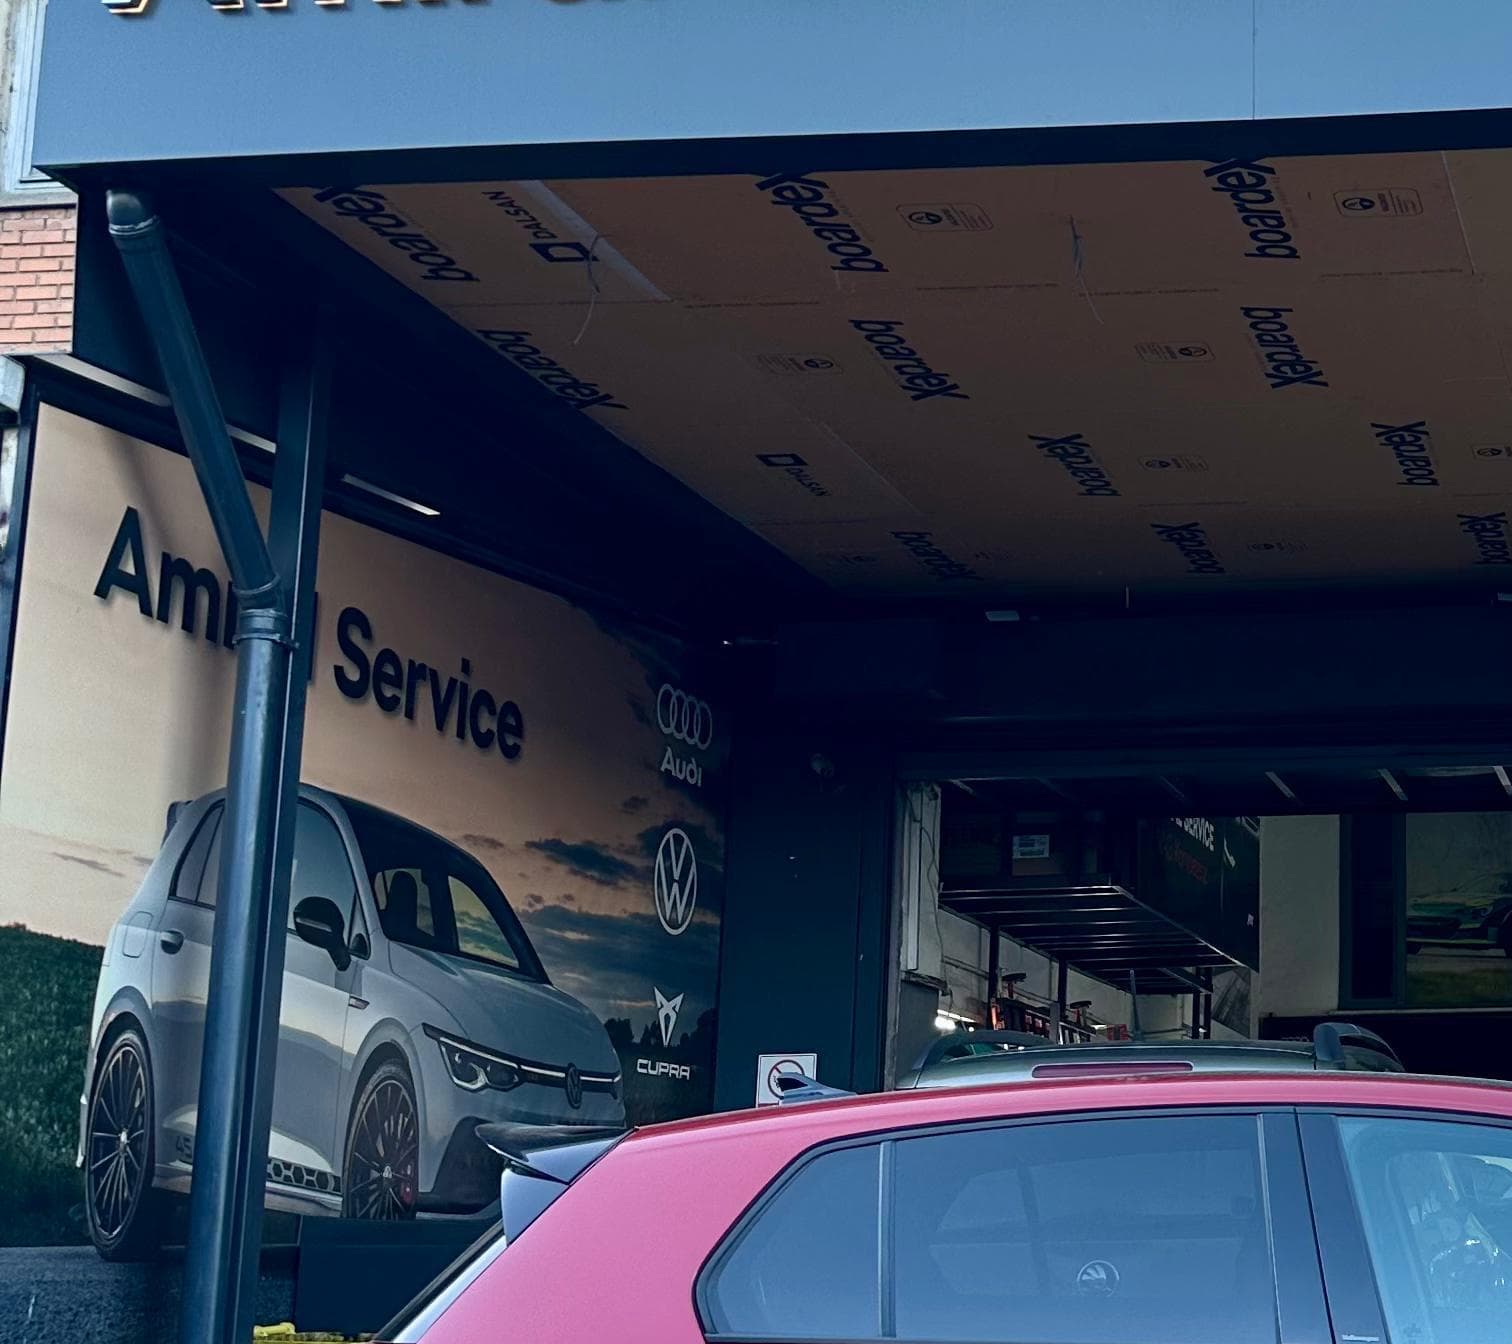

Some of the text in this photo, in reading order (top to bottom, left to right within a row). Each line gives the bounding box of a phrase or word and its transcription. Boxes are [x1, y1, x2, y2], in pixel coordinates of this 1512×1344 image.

[481, 191, 557, 240] DALSAN
[333, 606, 525, 759] Service
[660, 746, 704, 788] Audi
[636, 1058, 692, 1082] CUPRA
